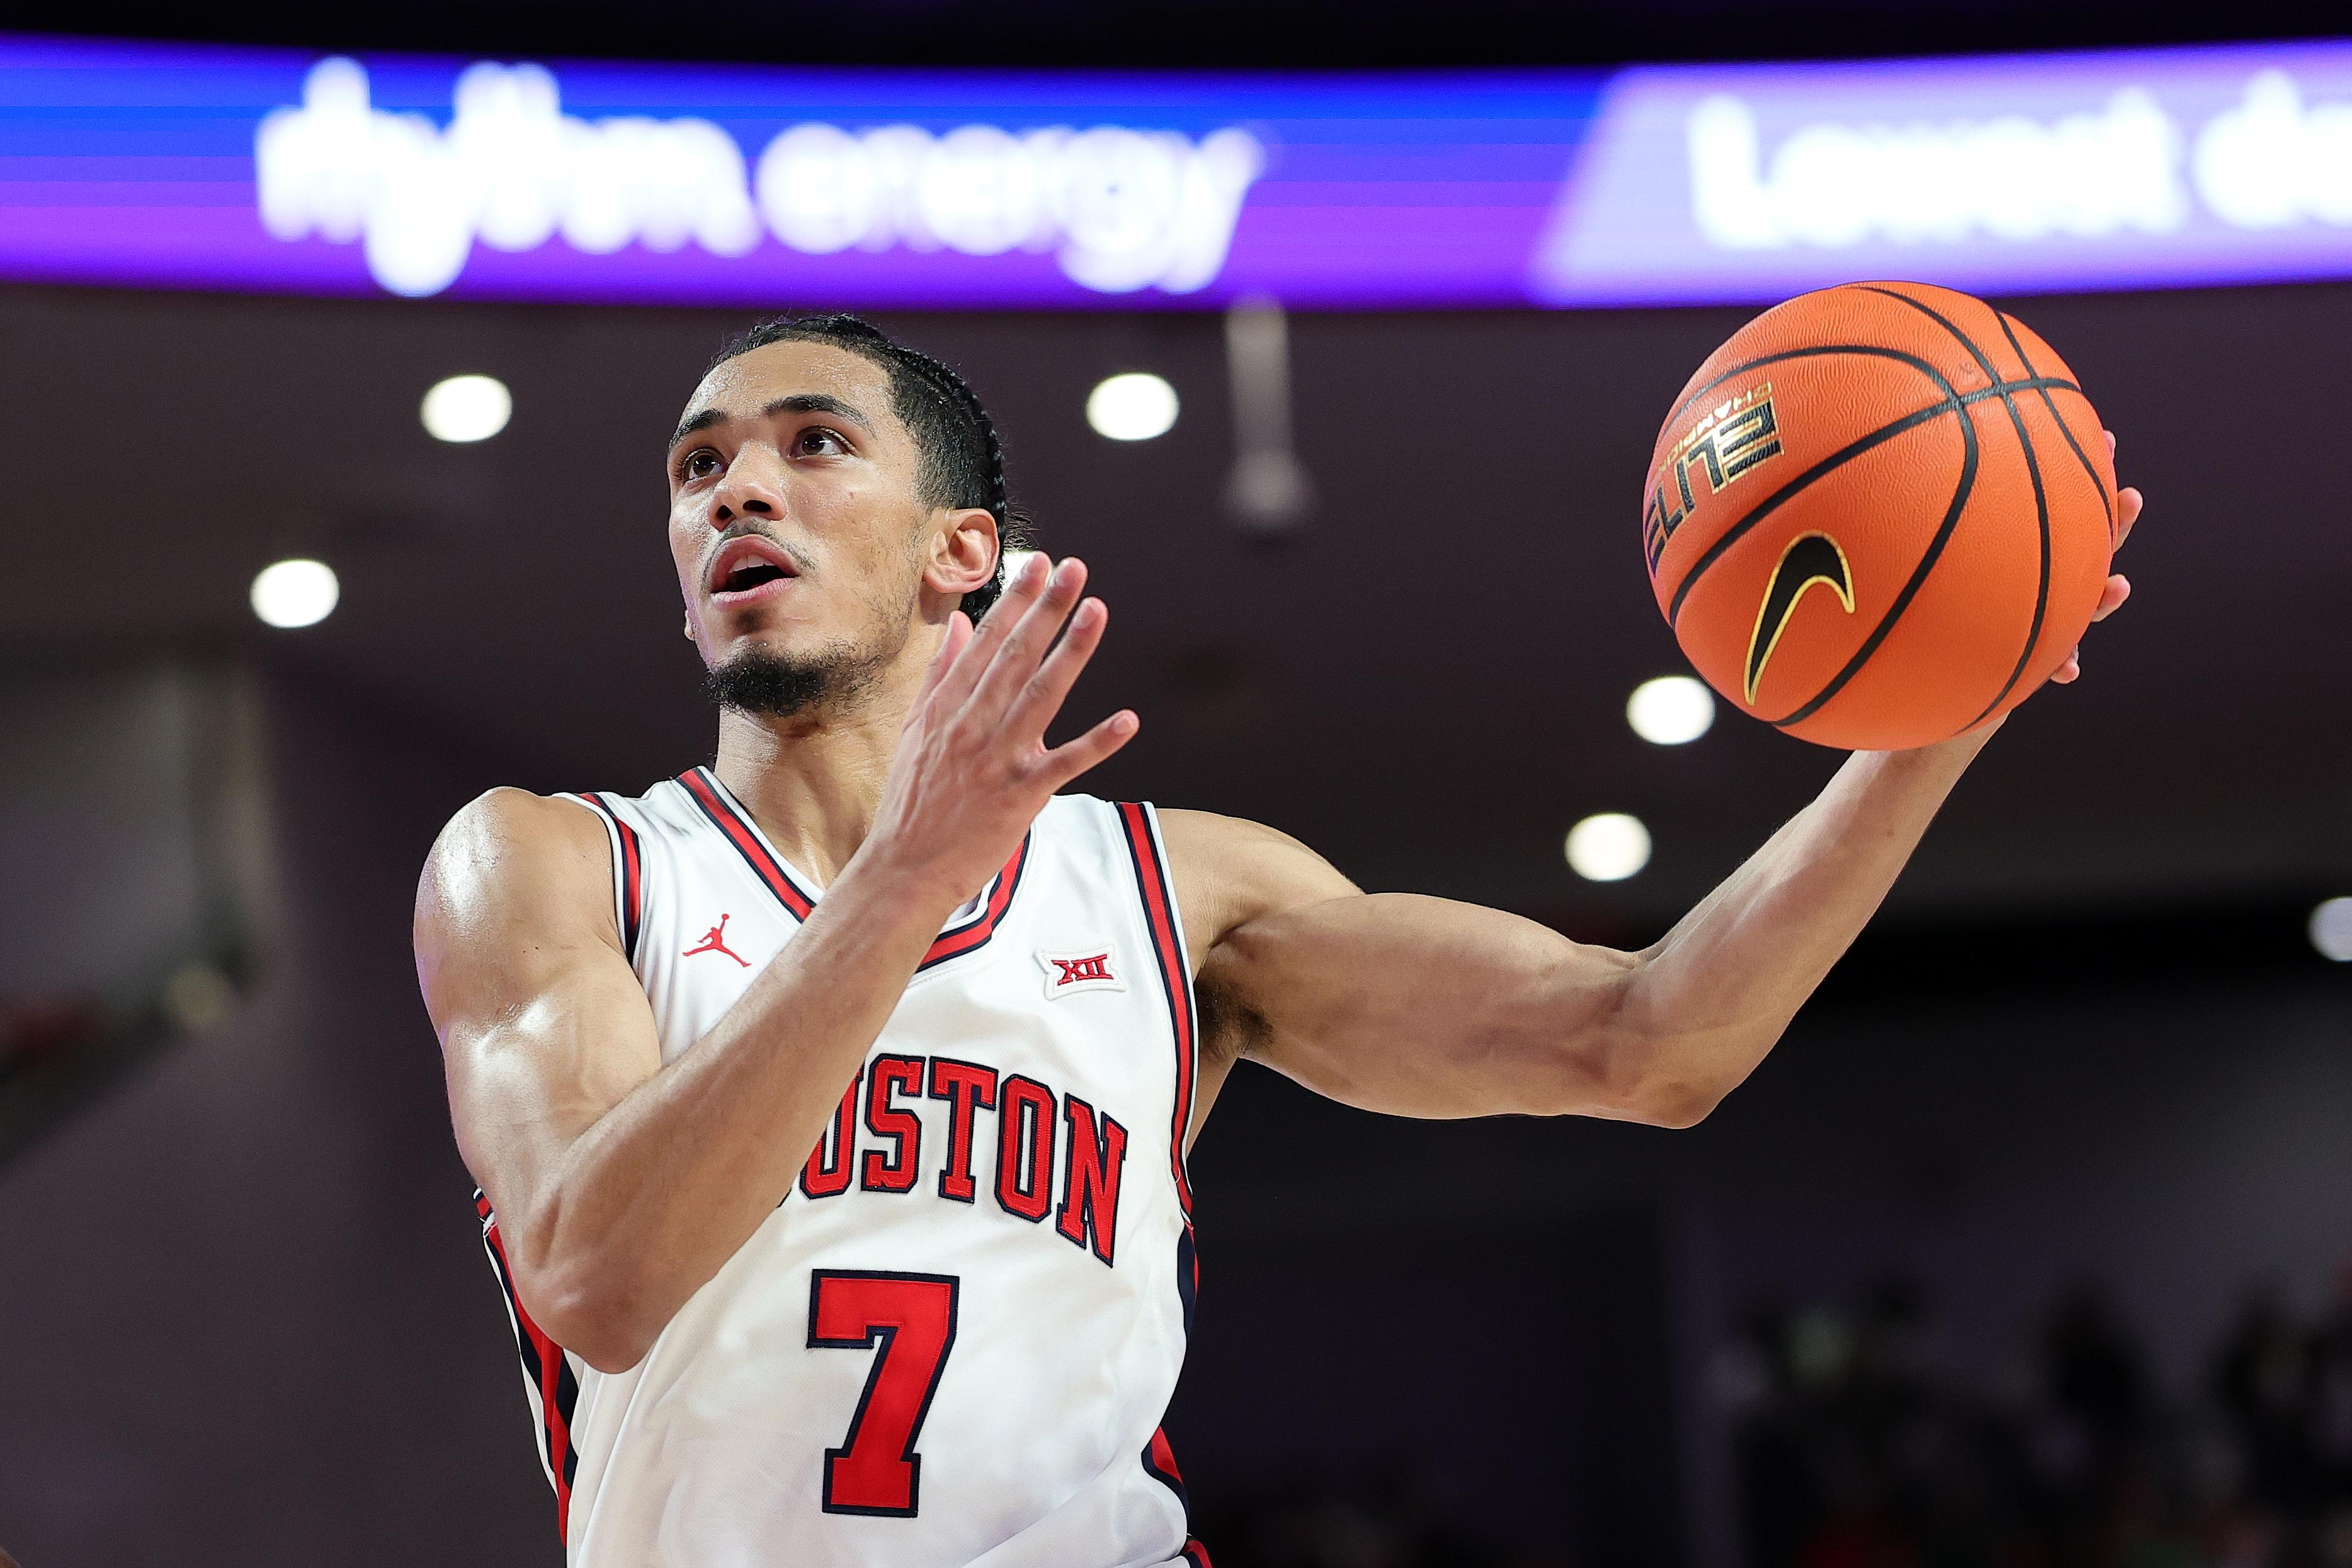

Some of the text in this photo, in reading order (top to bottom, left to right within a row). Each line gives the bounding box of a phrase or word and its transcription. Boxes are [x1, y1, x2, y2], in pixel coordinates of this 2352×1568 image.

[1643, 395, 1785, 579] ELITE
[1051, 953, 1114, 986] XII
[778, 1053, 1128, 1268] USTON
[807, 1268, 960, 1518] 7
